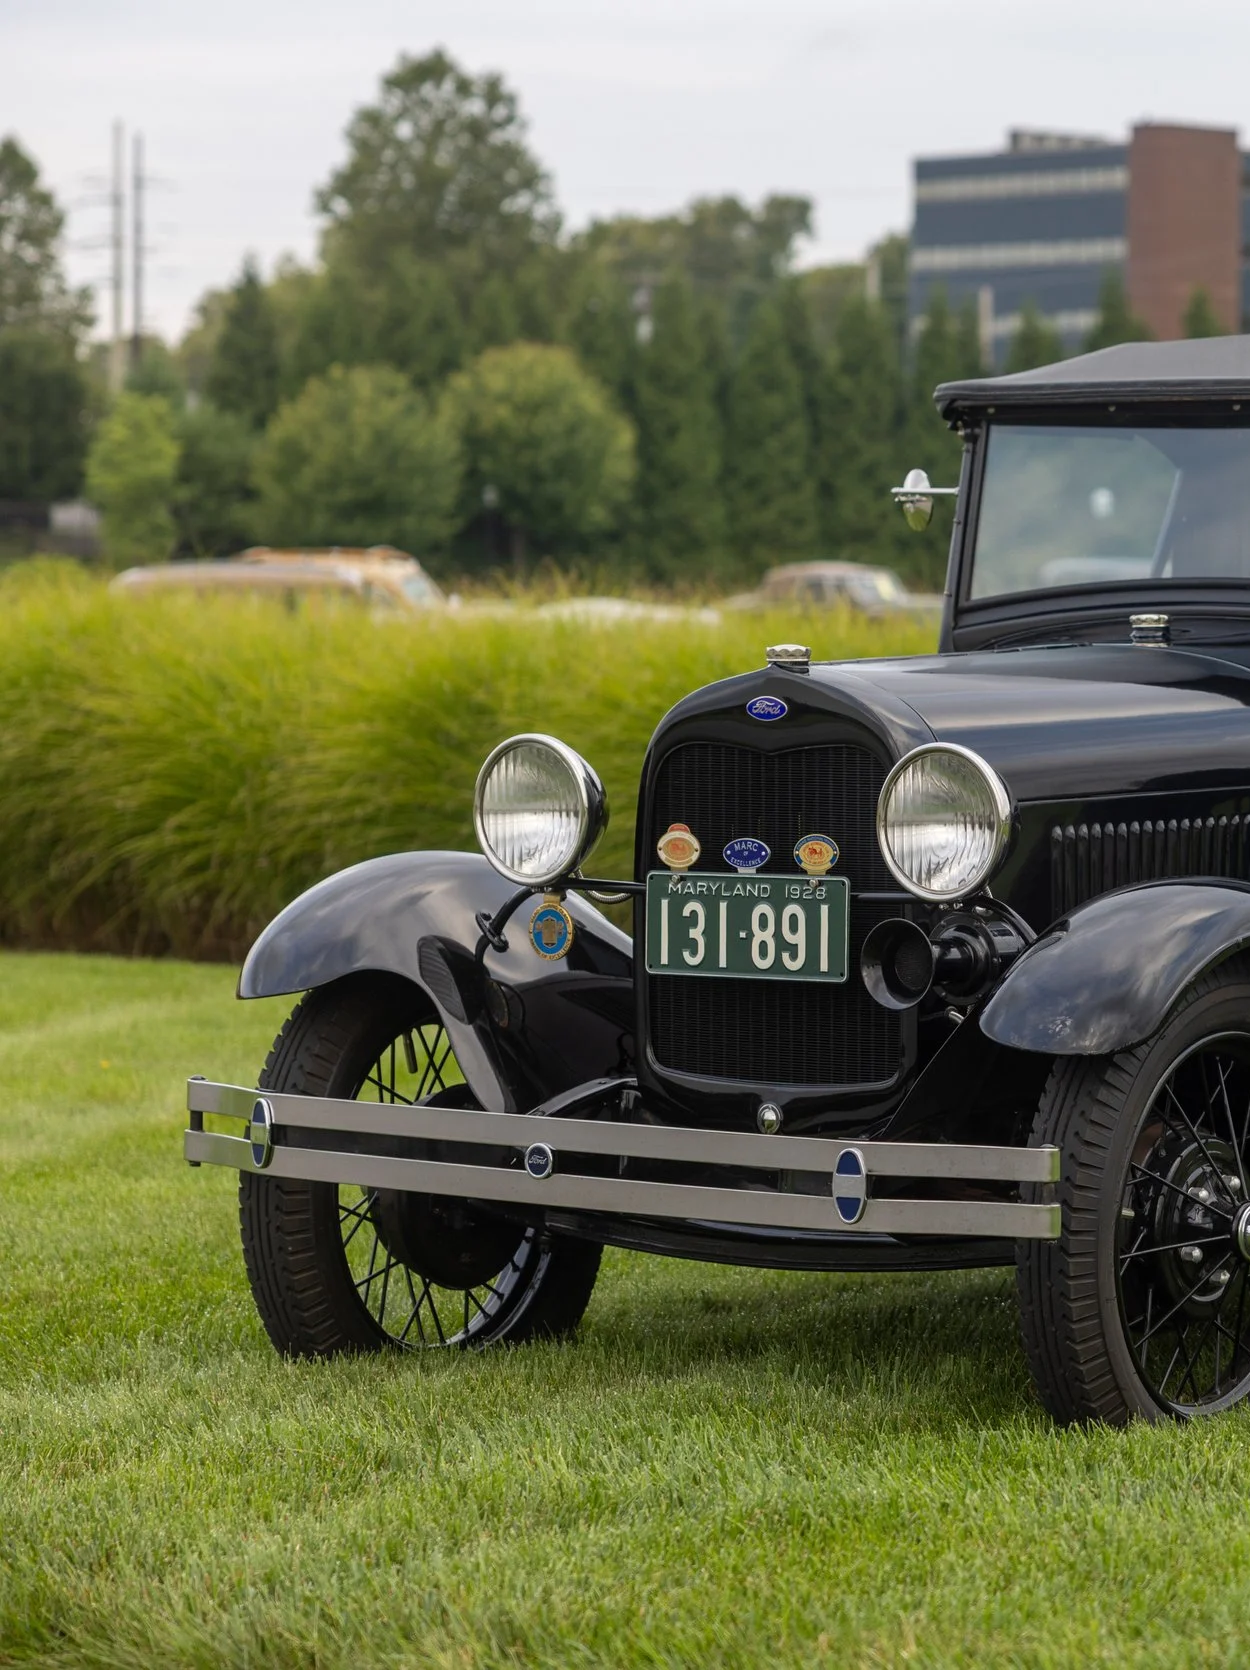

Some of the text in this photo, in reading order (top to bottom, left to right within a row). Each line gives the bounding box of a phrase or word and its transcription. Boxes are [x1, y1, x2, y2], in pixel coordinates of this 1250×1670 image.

[752, 699, 781, 715] Ford
[733, 841, 759, 852] MARC
[730, 856, 761, 867] EXCELLENCE
[667, 881, 828, 900] MARYLAND 1928
[660, 898, 830, 973] 131-891
[528, 1154, 548, 1165] Ford
